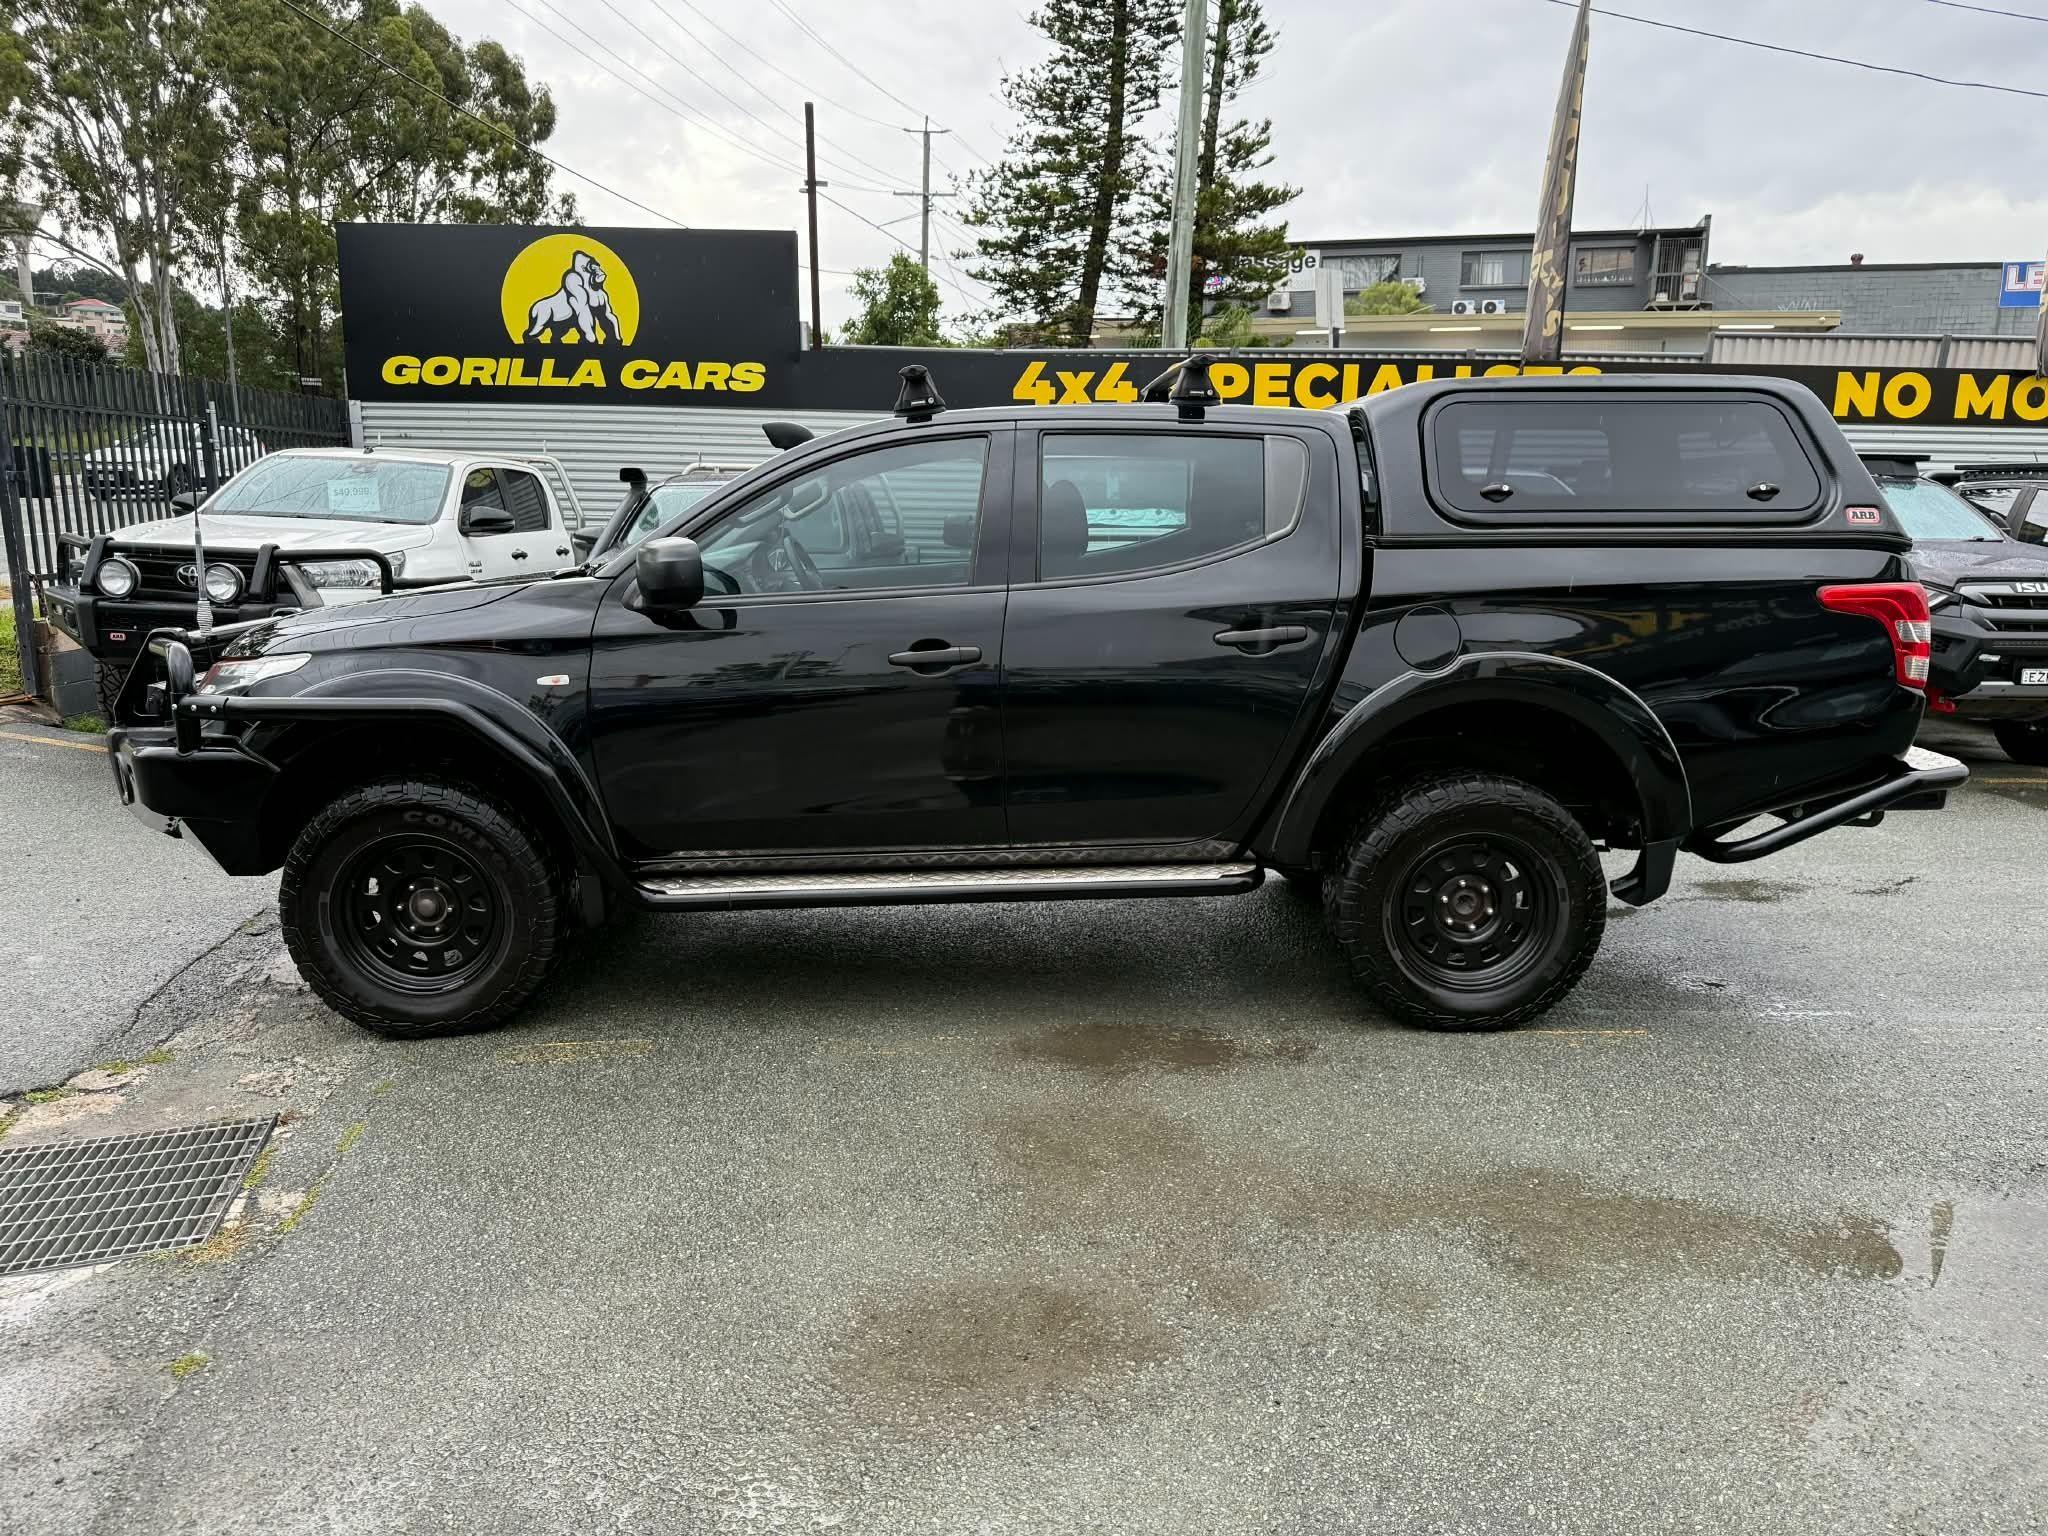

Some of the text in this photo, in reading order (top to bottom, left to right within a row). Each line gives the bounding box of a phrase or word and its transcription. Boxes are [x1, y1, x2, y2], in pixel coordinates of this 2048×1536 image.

[382, 355, 765, 392] GORILLA CARS
[1012, 361, 1137, 406] 4x4
[1832, 371, 1932, 419] NO
